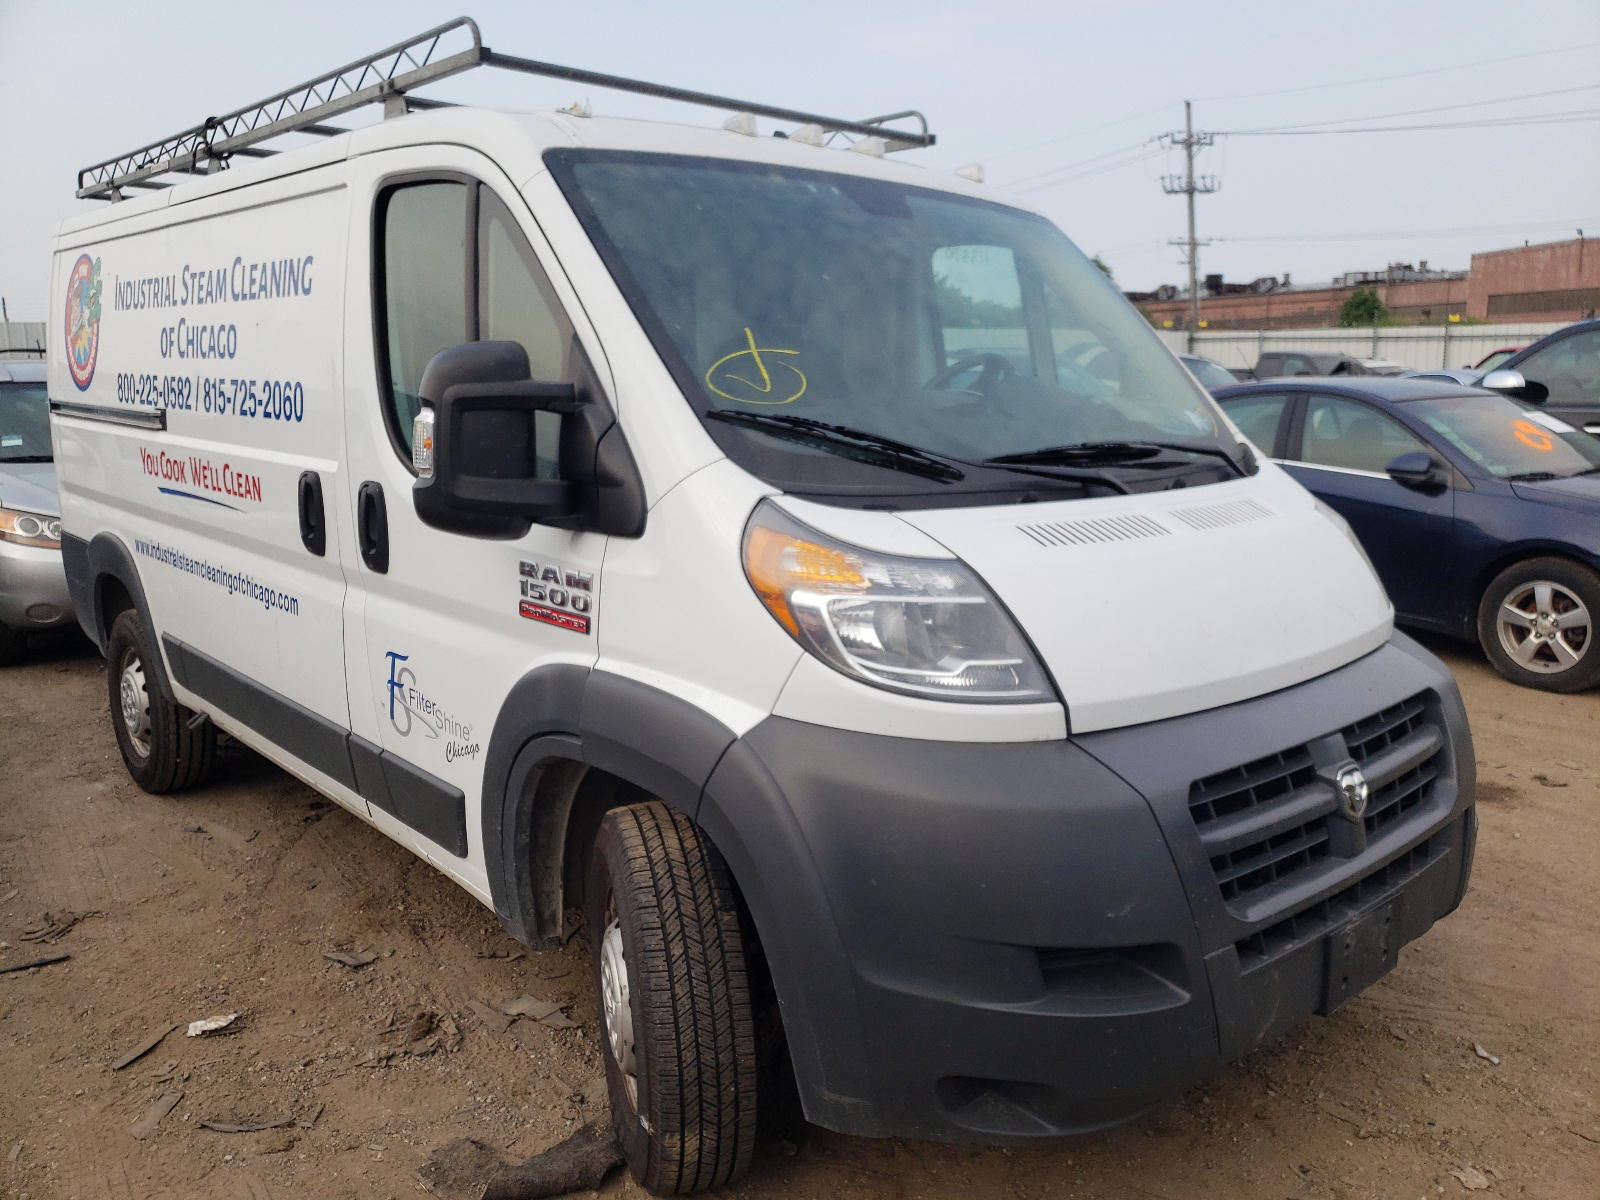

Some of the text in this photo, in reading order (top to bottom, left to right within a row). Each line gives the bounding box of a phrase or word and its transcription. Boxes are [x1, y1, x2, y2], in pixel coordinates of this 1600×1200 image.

[115, 255, 314, 312] INDUSTRIAL STEAM CLEANING
[160, 317, 237, 360] OF CHICAGO
[117, 372, 192, 411] 800-225-0582
[203, 378, 304, 423] 815-725-2060
[223, 463, 263, 503] CLEAN
[134, 537, 300, 617] www.industrialsteamcleaningofchicago.com
[519, 560, 594, 592] RAM
[519, 579, 593, 613] 1500
[445, 741, 481, 763] Chicago
